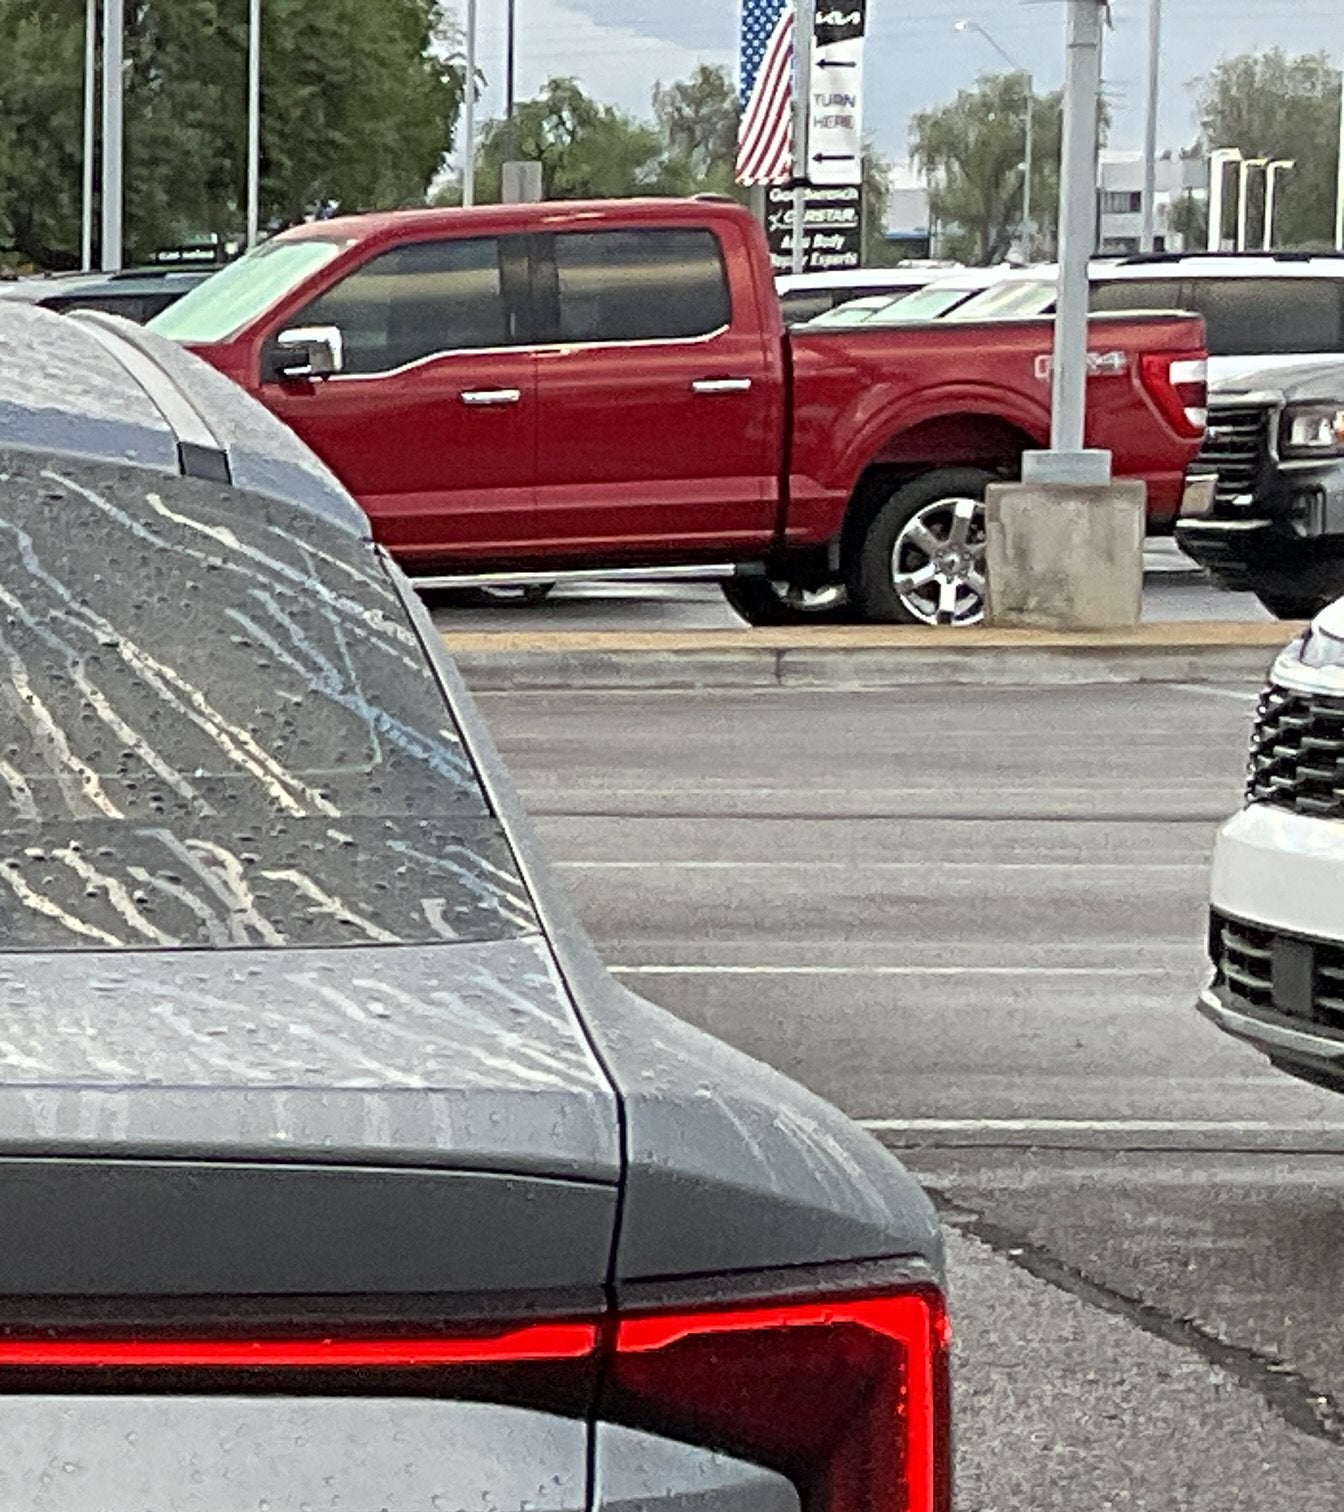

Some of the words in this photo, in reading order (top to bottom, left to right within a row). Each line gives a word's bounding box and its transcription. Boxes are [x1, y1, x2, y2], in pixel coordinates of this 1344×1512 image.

[813, 94, 856, 107] TURN
[813, 115, 854, 128] HERE
[783, 208, 855, 223] CRSTAR
